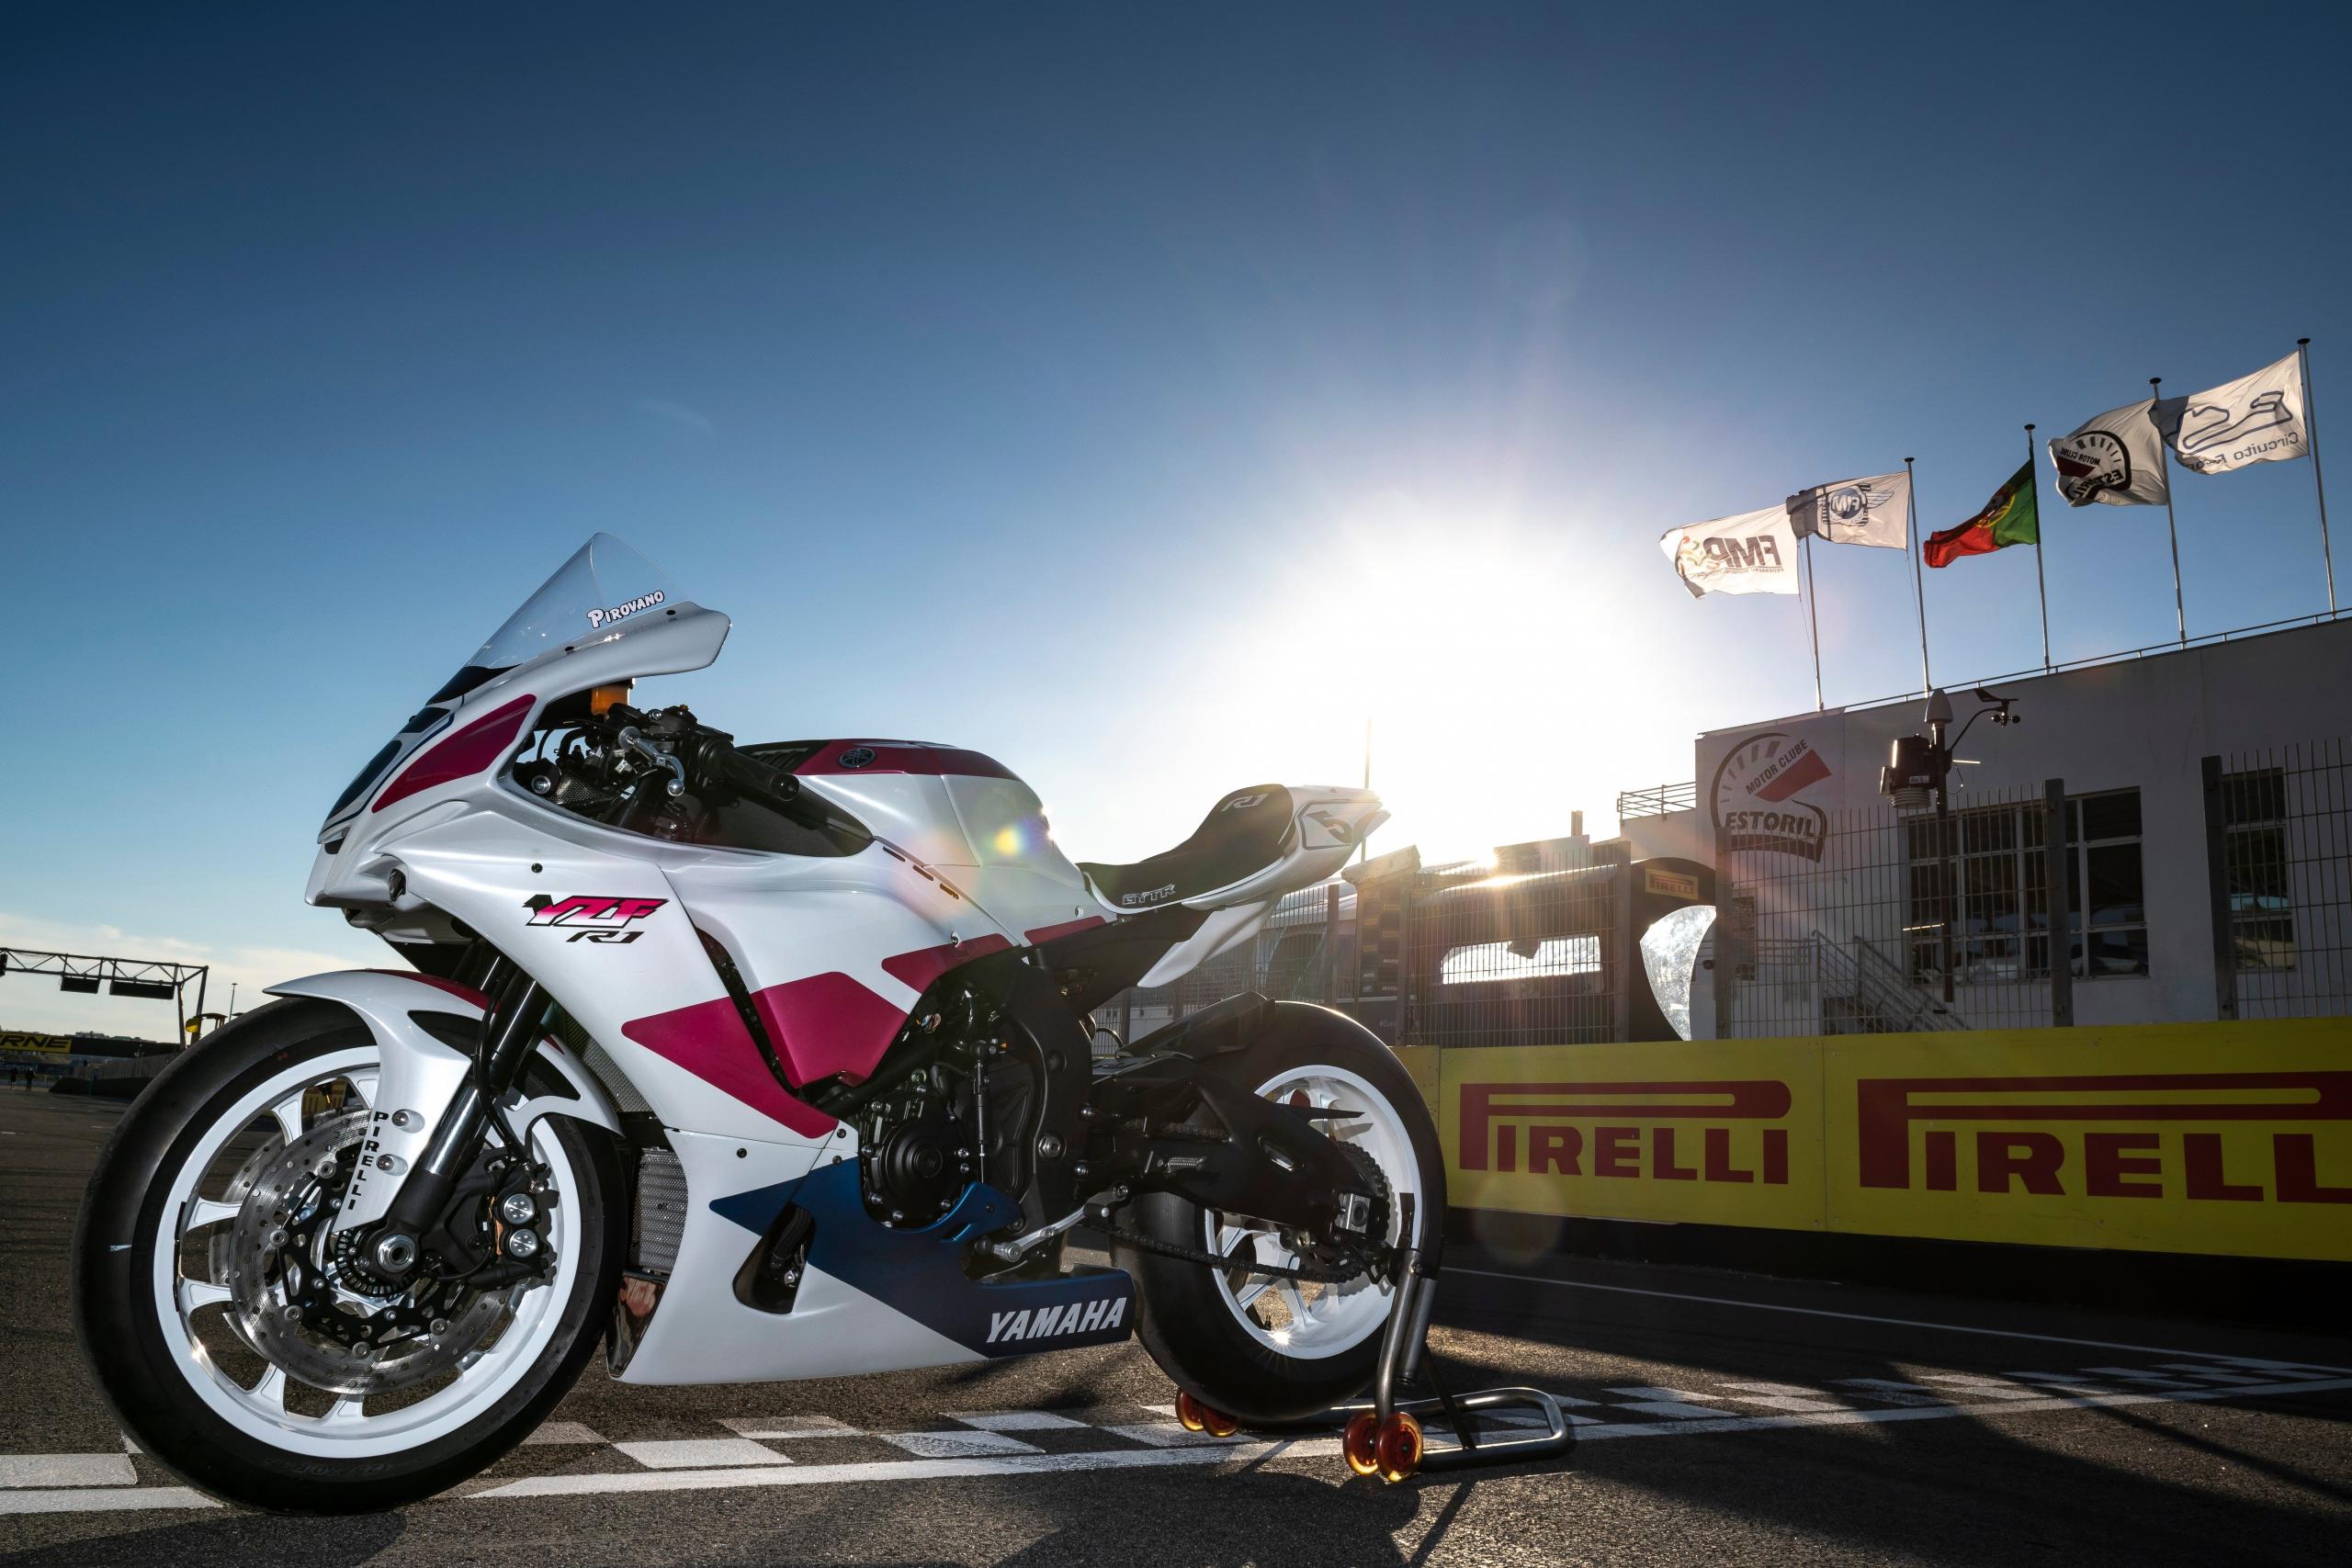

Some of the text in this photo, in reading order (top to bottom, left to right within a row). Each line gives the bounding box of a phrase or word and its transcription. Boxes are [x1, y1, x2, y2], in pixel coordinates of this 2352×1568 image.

[587, 590, 664, 628] PIROVANO
[1746, 739, 1808, 795] MOTOR CLUBE
[1221, 793, 1269, 812] R1
[1725, 811, 1815, 837] ESTORIL
[1122, 884, 1175, 905] GYTR
[1650, 874, 1694, 895] PIRELLI
[522, 894, 670, 928] YZF
[566, 931, 645, 943] R1
[0, 1033, 70, 1049] RNE
[1459, 1080, 1792, 1184] PIRELLI
[1857, 1070, 2352, 1204] PIRELL
[348, 1111, 390, 1210] PIRELLI
[987, 1297, 1127, 1343] YAMAHA
